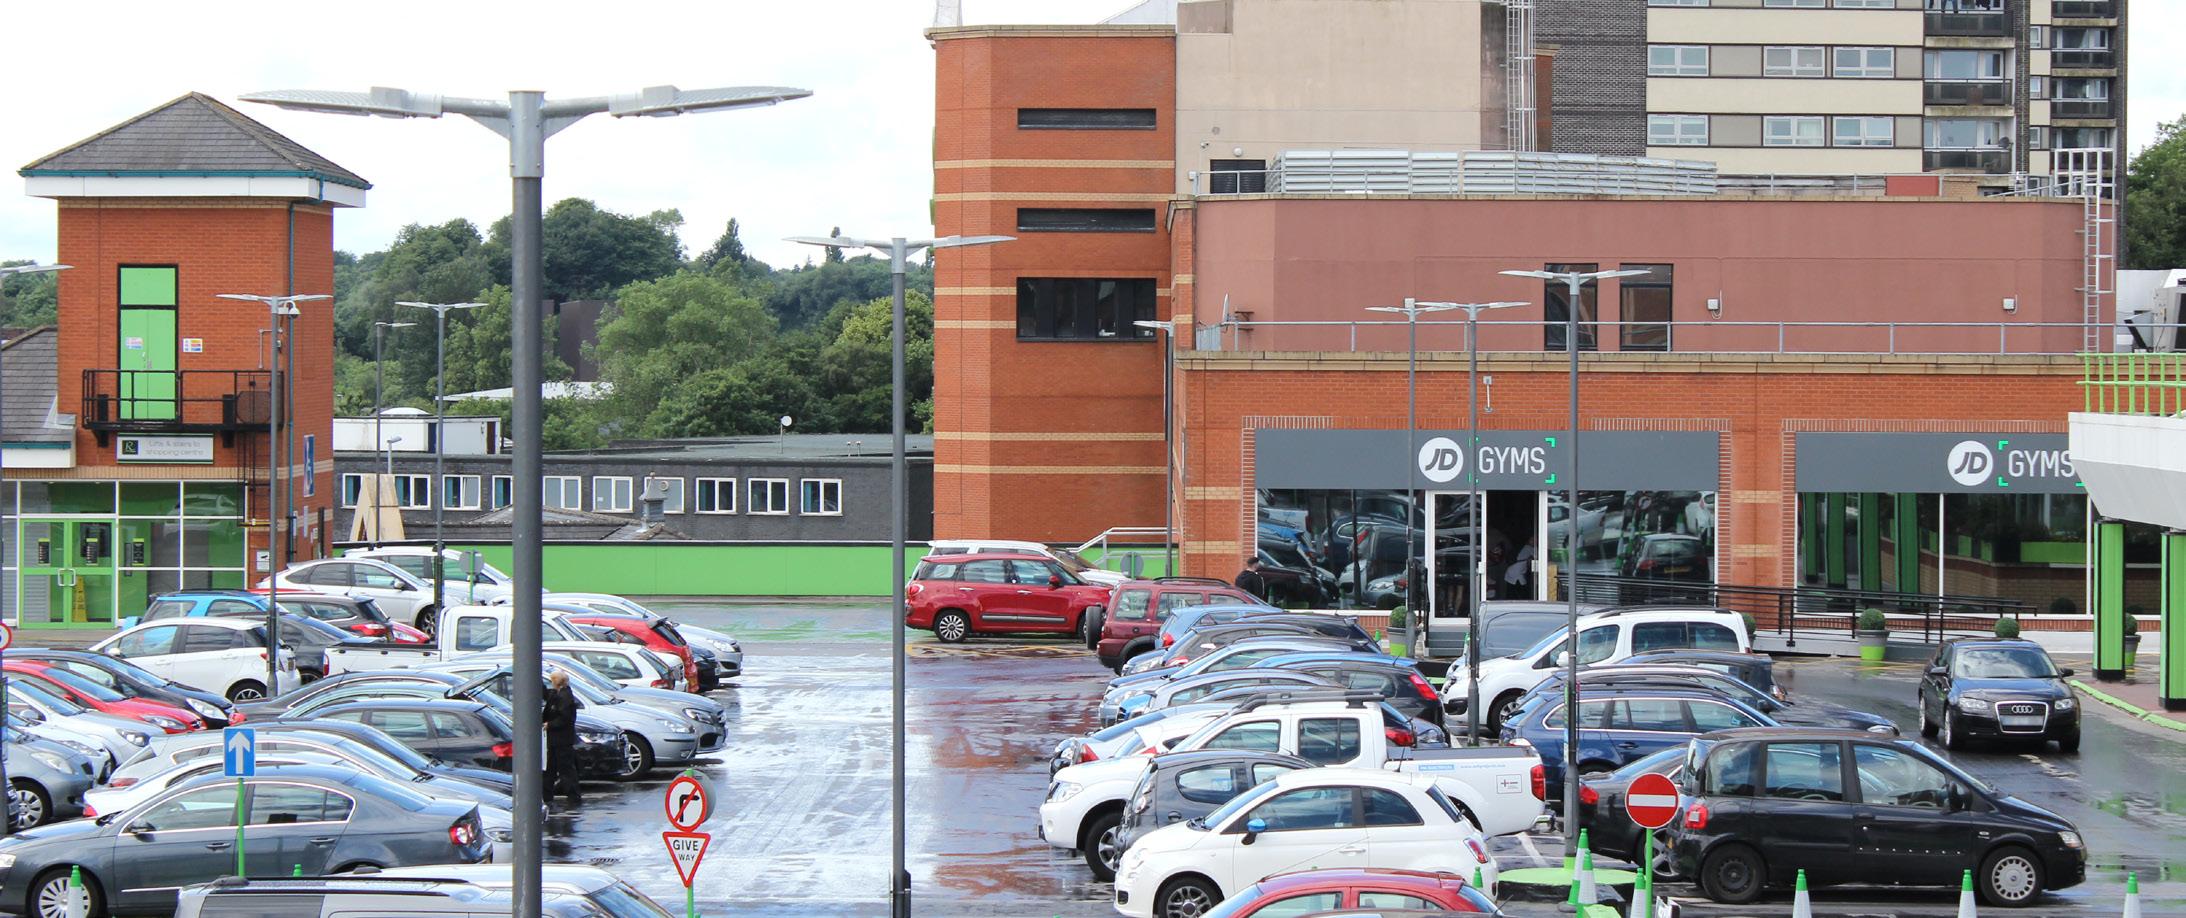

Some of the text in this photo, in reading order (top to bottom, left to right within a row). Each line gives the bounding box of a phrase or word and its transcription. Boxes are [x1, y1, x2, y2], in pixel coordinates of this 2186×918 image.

[1425, 446, 1545, 474] JD GYMS
[1954, 449, 2076, 477] JD GYMS
[673, 840, 699, 851] GIVE
[679, 853, 695, 861] WAY
